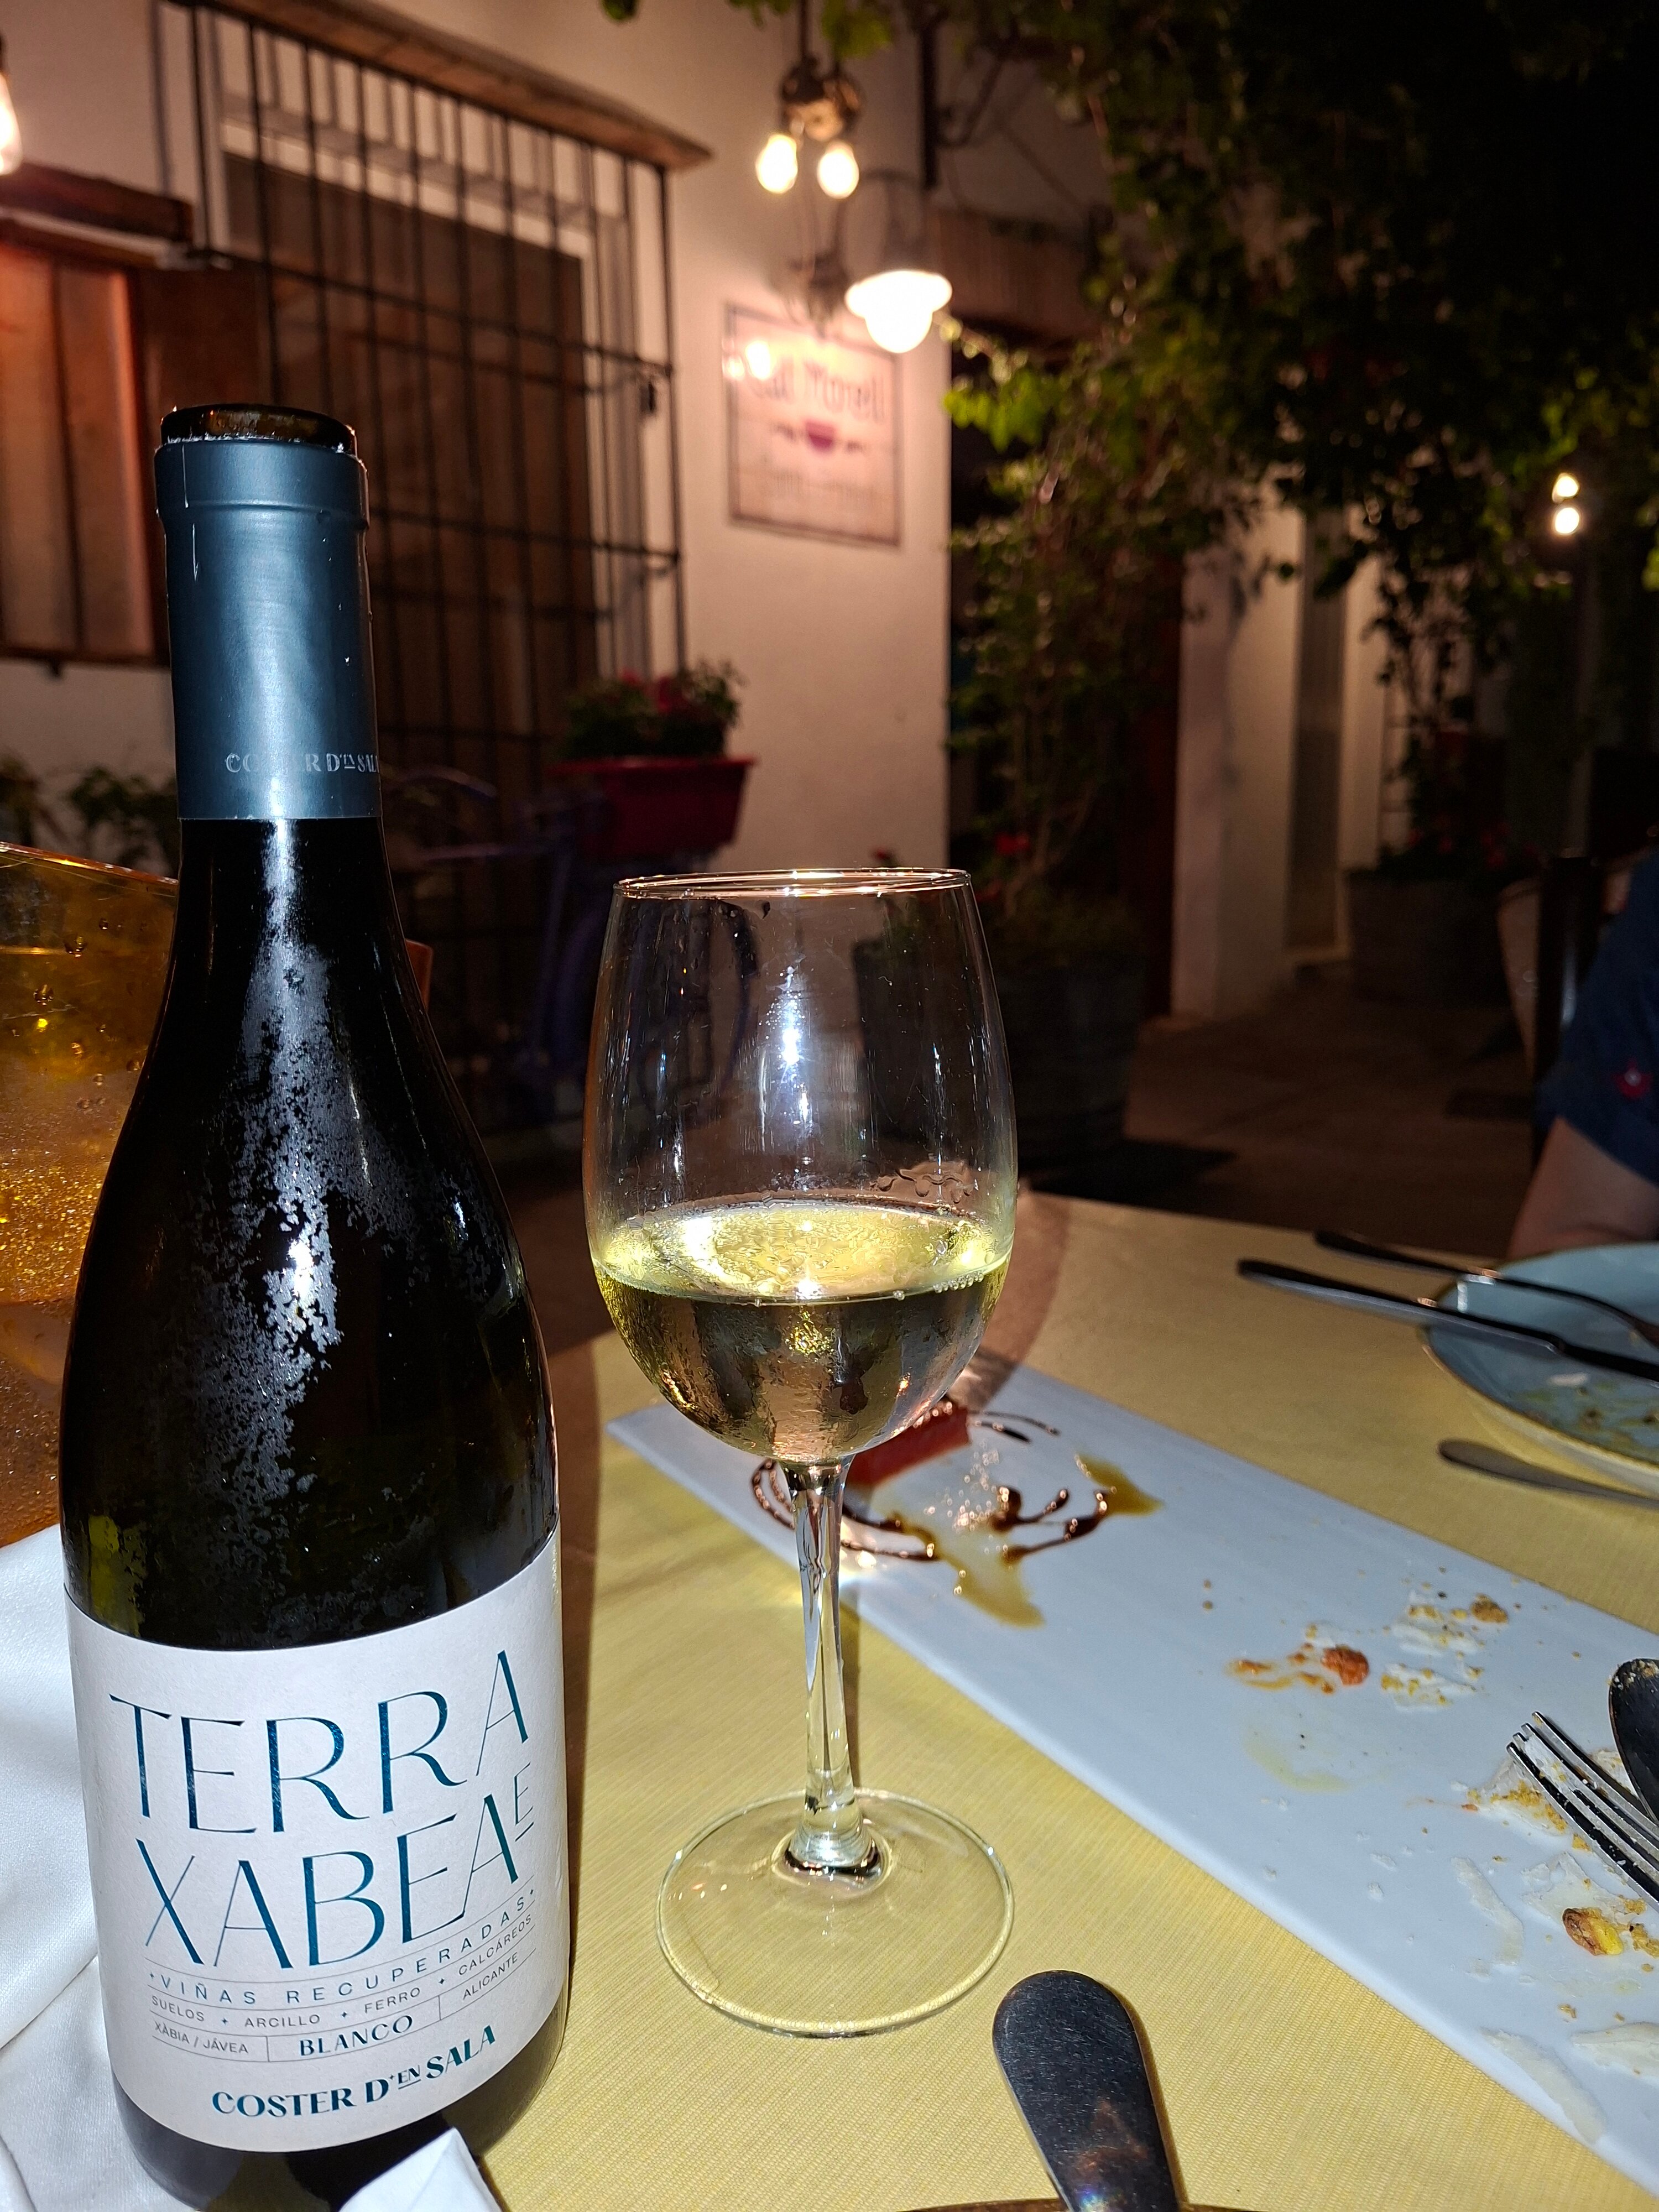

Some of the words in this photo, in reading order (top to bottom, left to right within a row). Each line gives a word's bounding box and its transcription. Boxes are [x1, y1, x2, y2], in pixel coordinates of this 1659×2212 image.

[109, 1649, 529, 1833] TERRA
[151, 1995, 205, 2022] SUELOS
[244, 2014, 320, 2028] ARCILLO
[364, 1986, 421, 2013] FERRO
[458, 1914, 531, 1975] CALCÁREOS
[160, 1974, 256, 2004] VIÑAS
[286, 1896, 524, 2004] RECUPERADAS
[462, 1952, 518, 2000] ALICANTE
[202, 2038, 248, 2054] JÁVEA
[211, 2087, 358, 2117] COSTER
[425, 2025, 496, 2080] SALA
[299, 2015, 413, 2057] BLANCO
